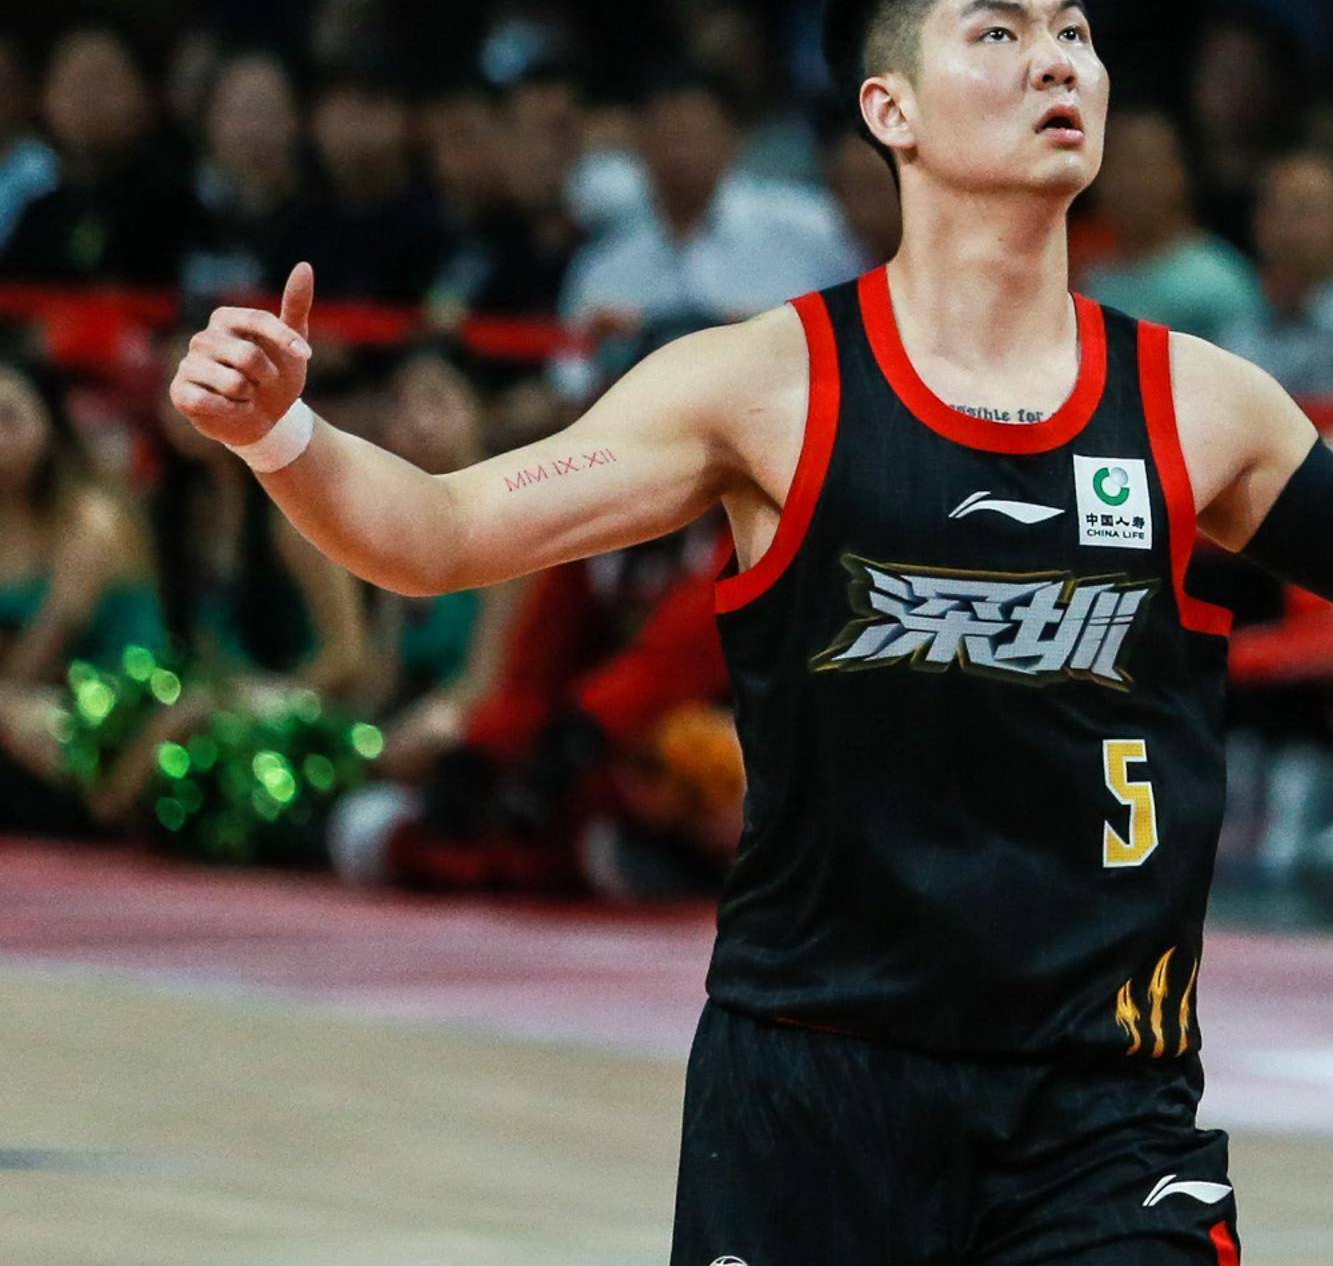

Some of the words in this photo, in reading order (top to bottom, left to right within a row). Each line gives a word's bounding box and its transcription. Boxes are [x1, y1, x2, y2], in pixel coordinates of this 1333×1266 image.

[1086, 513, 1145, 529] 中国人寿
[1086, 529, 1119, 538] CHINA
[1122, 531, 1145, 540] LIFE
[825, 562, 1153, 685] 深圳
[1103, 739, 1159, 868] 5
